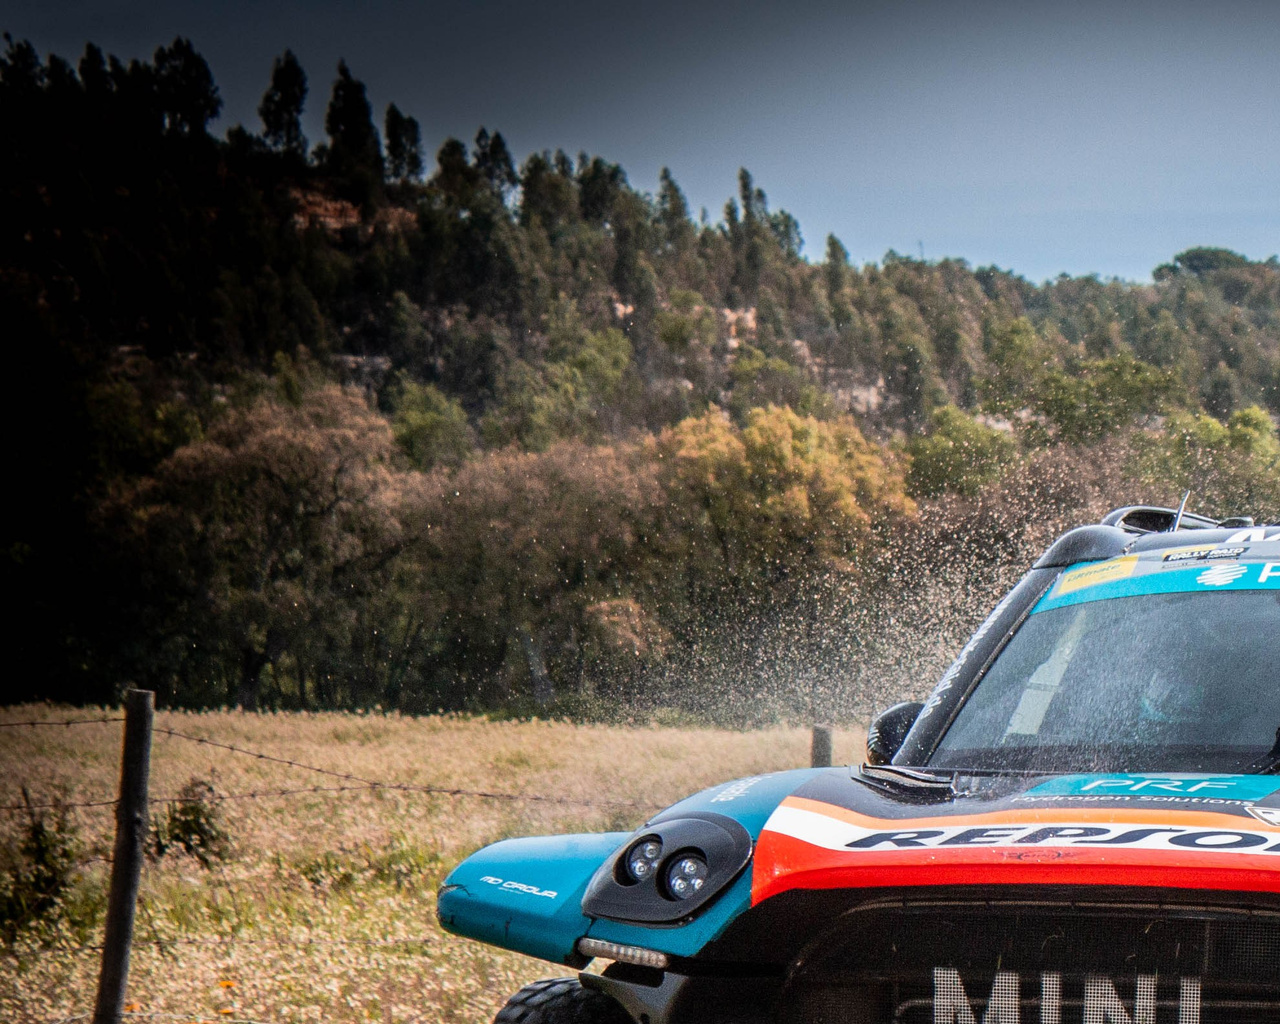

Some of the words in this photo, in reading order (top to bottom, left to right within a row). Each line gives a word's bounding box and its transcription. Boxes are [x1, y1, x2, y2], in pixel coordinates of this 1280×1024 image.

[1168, 550, 1208, 561] RALLY
[1209, 547, 1245, 556] RAID
[1081, 778, 1237, 793] PRF
[1140, 795, 1256, 807] Solutions
